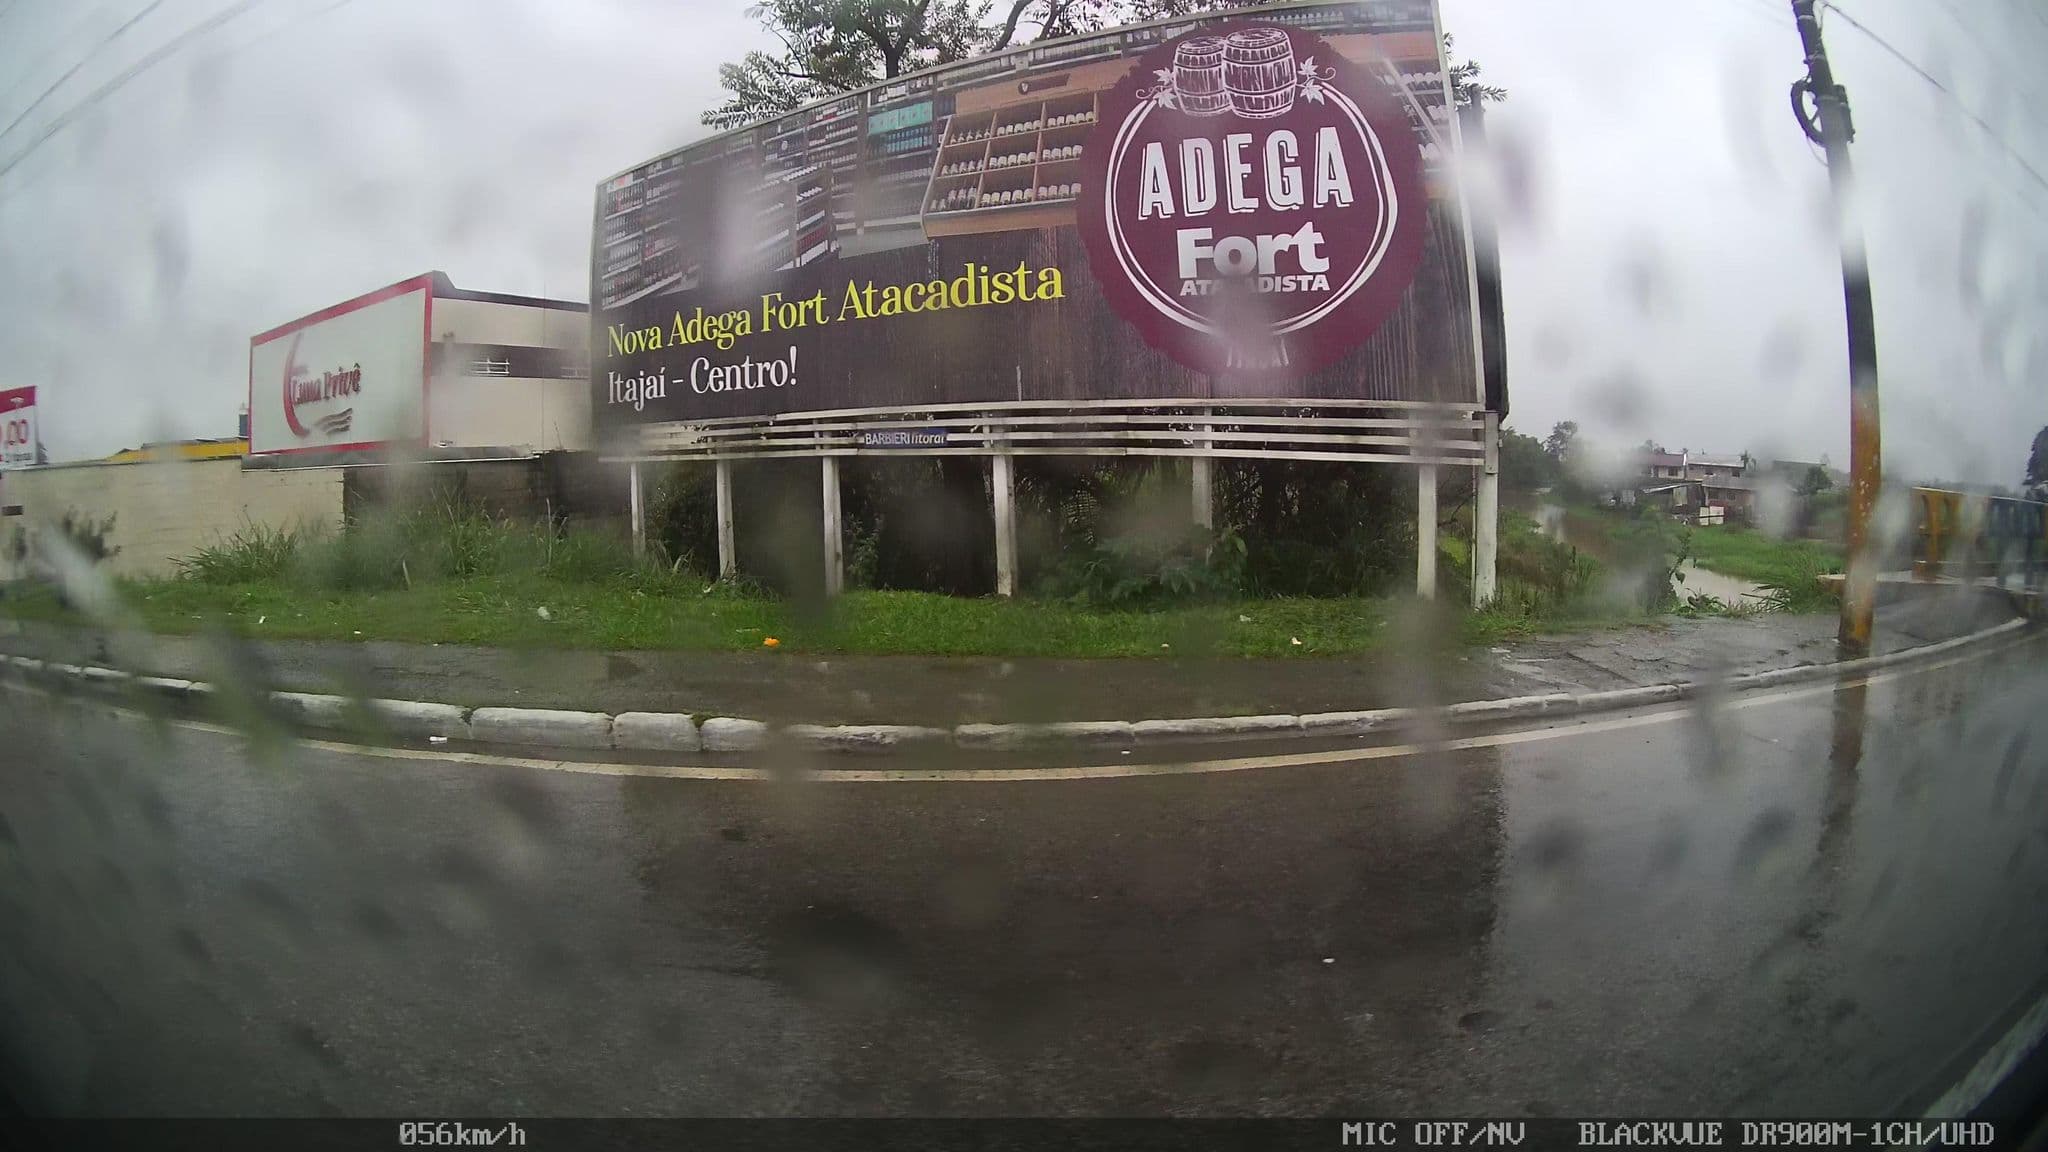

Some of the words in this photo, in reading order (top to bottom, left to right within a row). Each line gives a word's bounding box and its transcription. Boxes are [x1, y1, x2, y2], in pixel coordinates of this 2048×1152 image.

[1137, 126, 1354, 221] ADEGA
[1176, 221, 1330, 279] Fort
[607, 323, 662, 358] Nova
[667, 307, 752, 350] Adega
[761, 289, 829, 333] Fort
[836, 260, 1066, 322] Atacadista
[608, 367, 666, 412] Itajaí
[690, 346, 797, 394] Centro!
